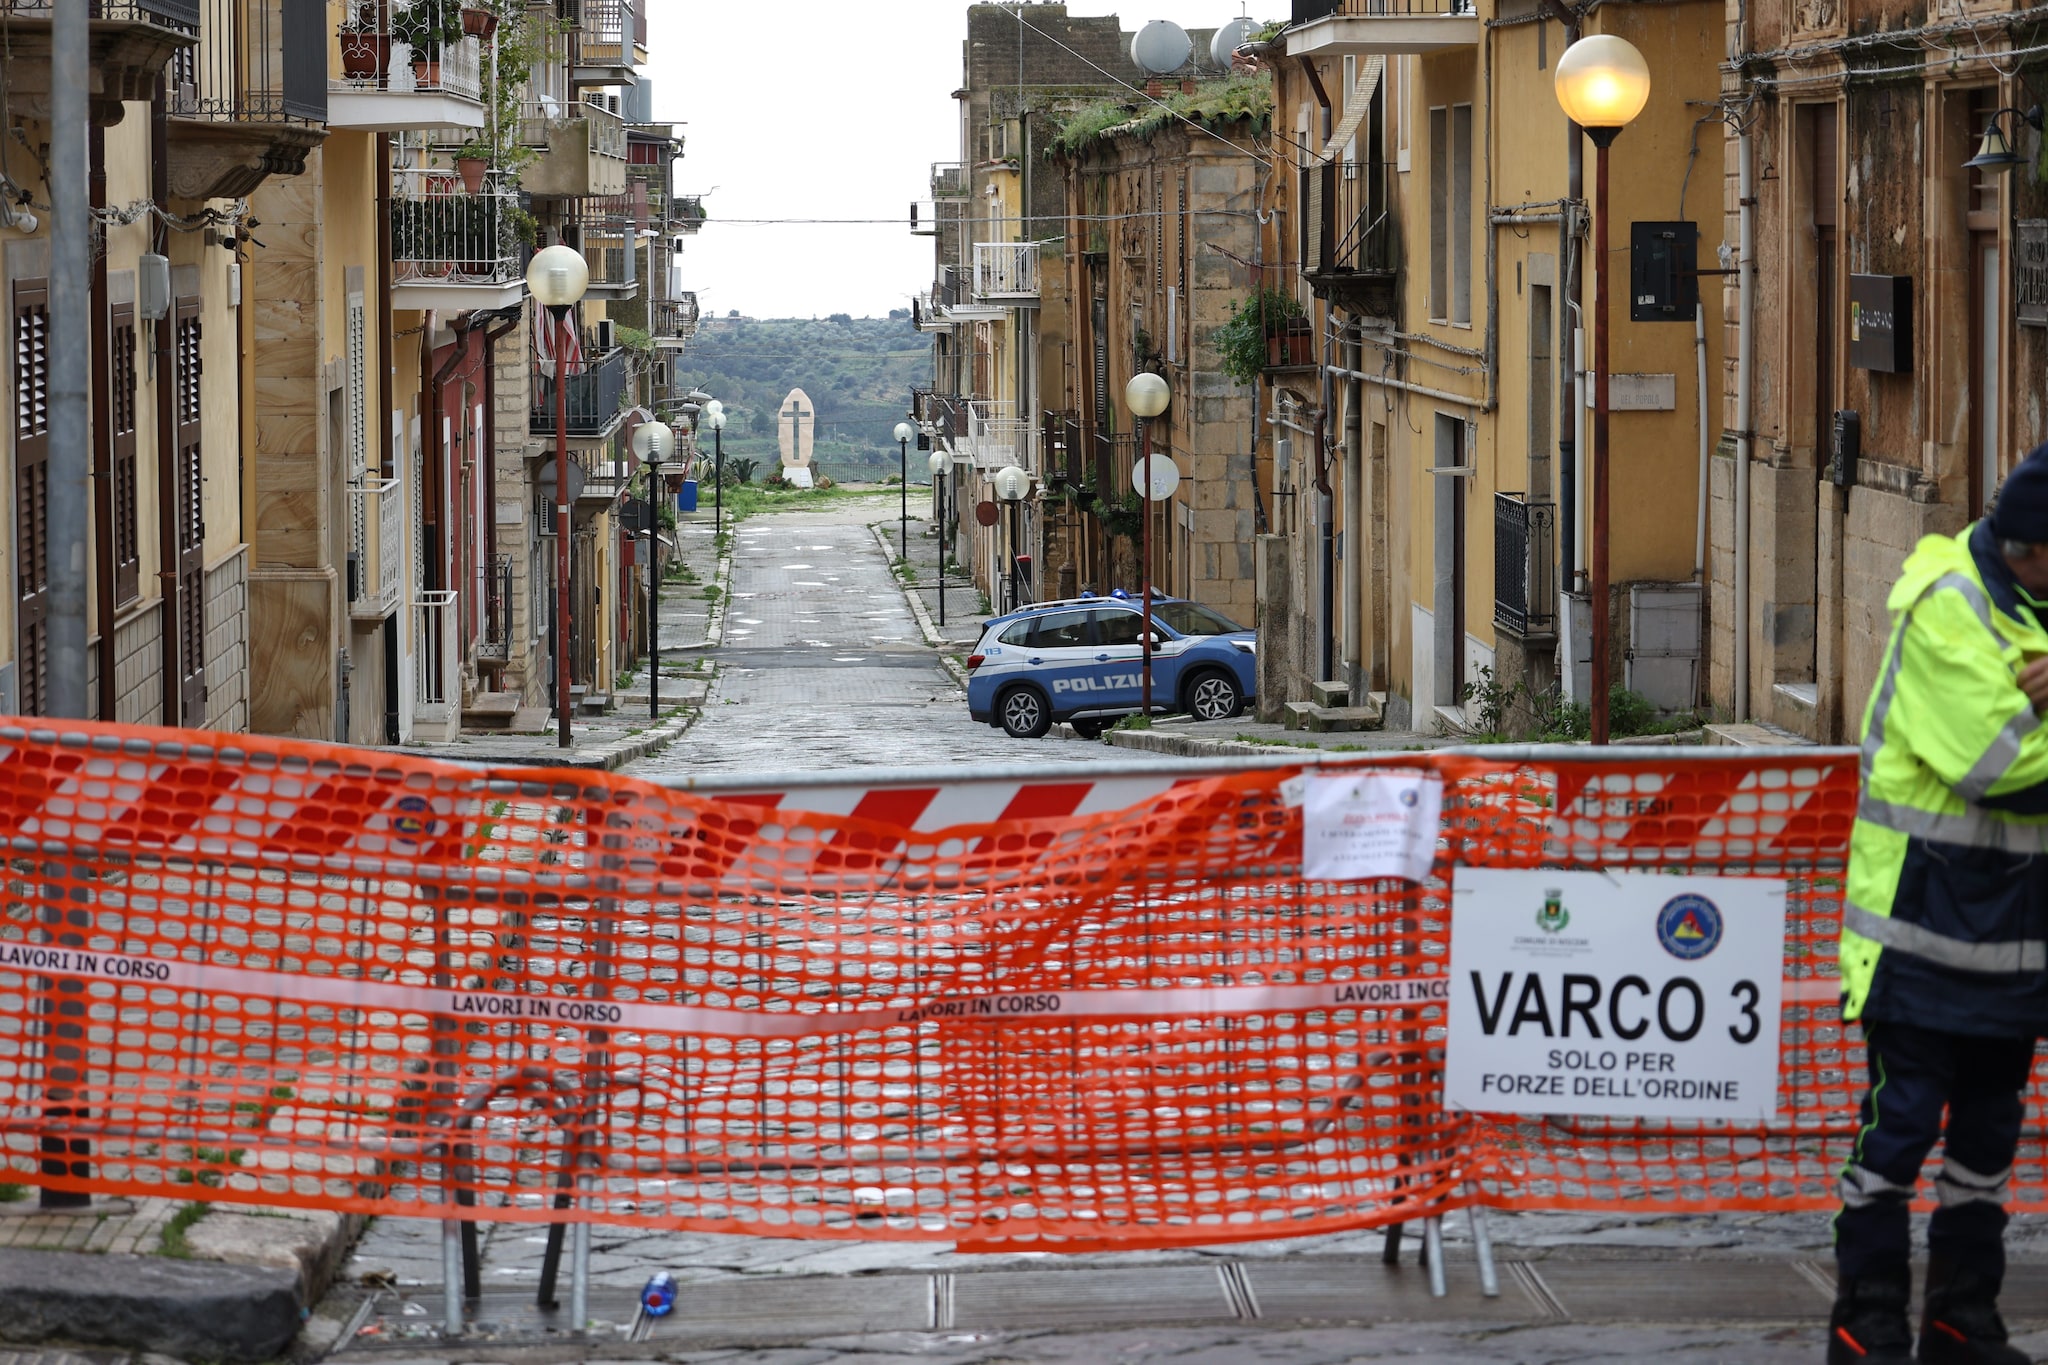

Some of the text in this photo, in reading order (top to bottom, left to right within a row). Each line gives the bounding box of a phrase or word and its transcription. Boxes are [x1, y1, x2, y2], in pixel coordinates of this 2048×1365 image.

[1620, 394, 1660, 405] DEL POPOLO
[984, 647, 1002, 656] 113
[1052, 673, 1156, 694] POLIZIA
[0, 944, 170, 981] LAVORI IN CORSO
[1335, 983, 1401, 1002] LAVORI
[1408, 981, 1428, 999] IN
[452, 995, 622, 1022] LAVORI IN CORSO
[898, 995, 1060, 1022] LAVORI IN CORSO
[1469, 970, 1761, 1045] VARCO 3
[1548, 1049, 1675, 1072] SOLO PER
[1482, 1073, 1738, 1101] FORZE DELL'ORDINE
